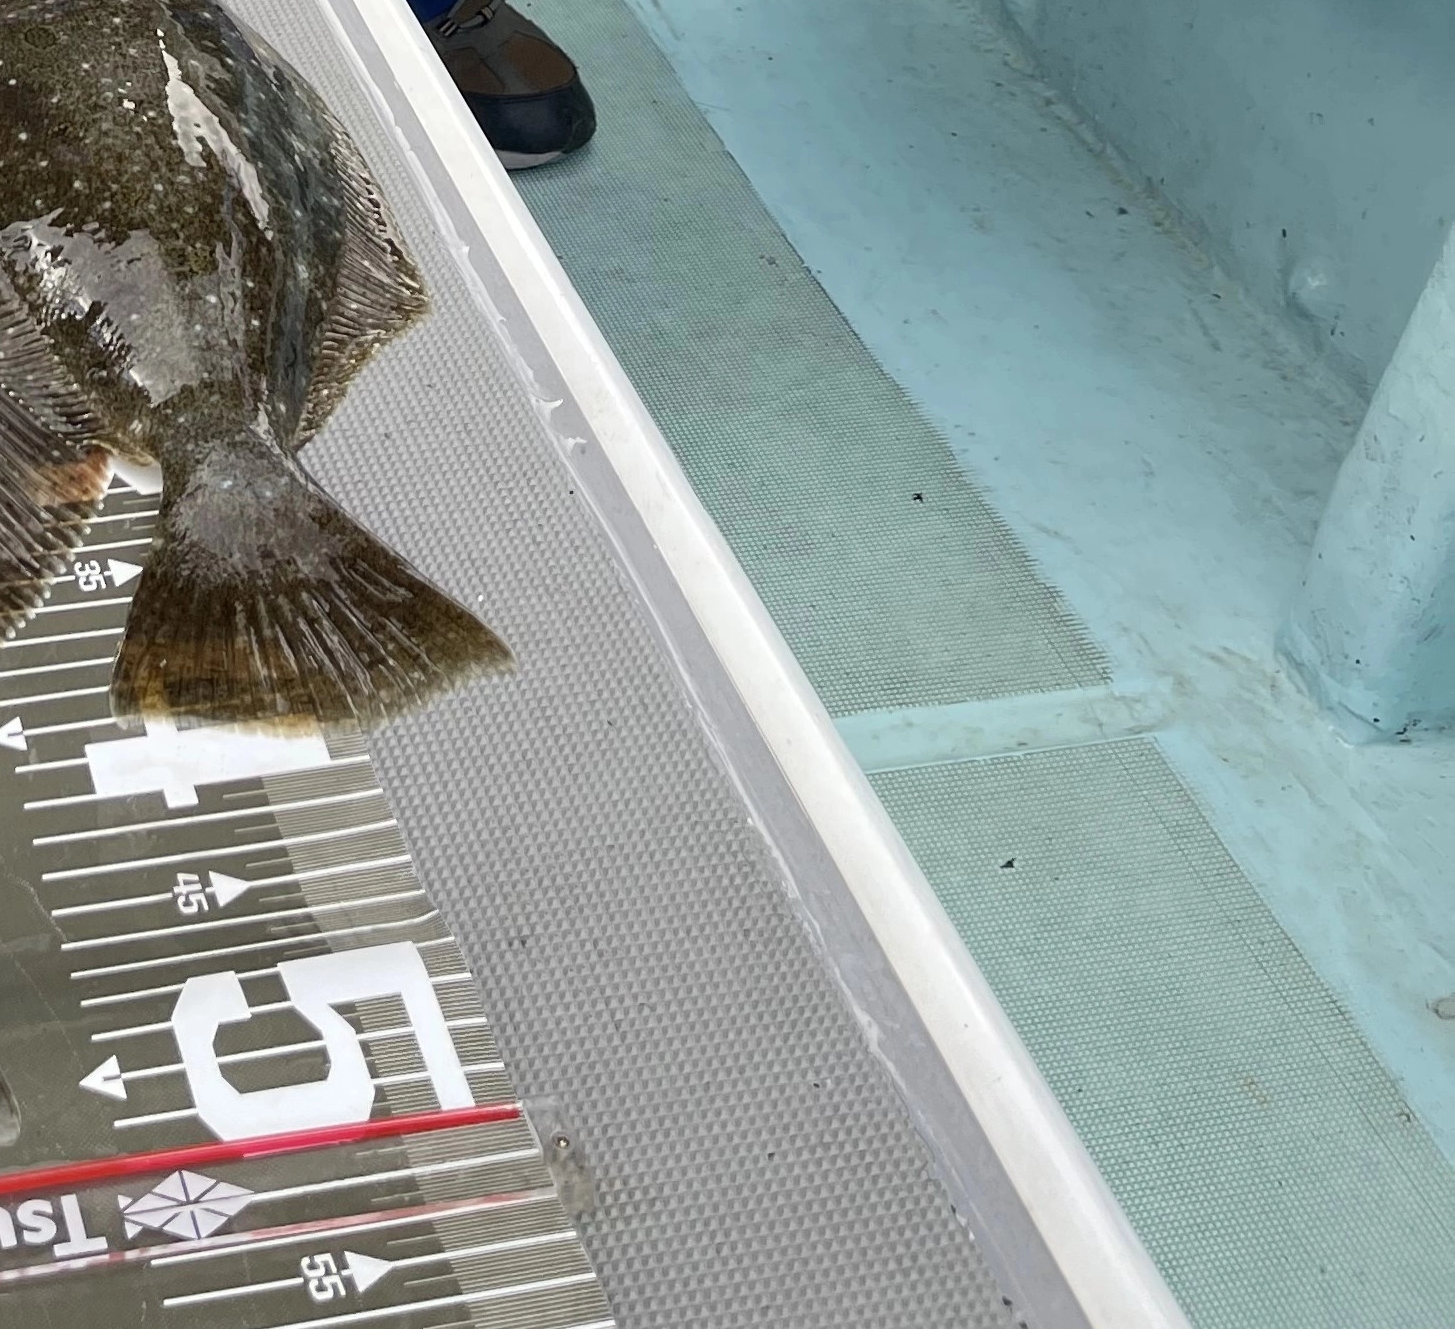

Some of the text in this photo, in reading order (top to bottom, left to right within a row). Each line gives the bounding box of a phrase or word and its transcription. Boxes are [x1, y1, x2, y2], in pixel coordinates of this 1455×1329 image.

[73, 559, 107, 593] 35
[171, 872, 211, 915] 45
[300, 1251, 347, 1301] 55
